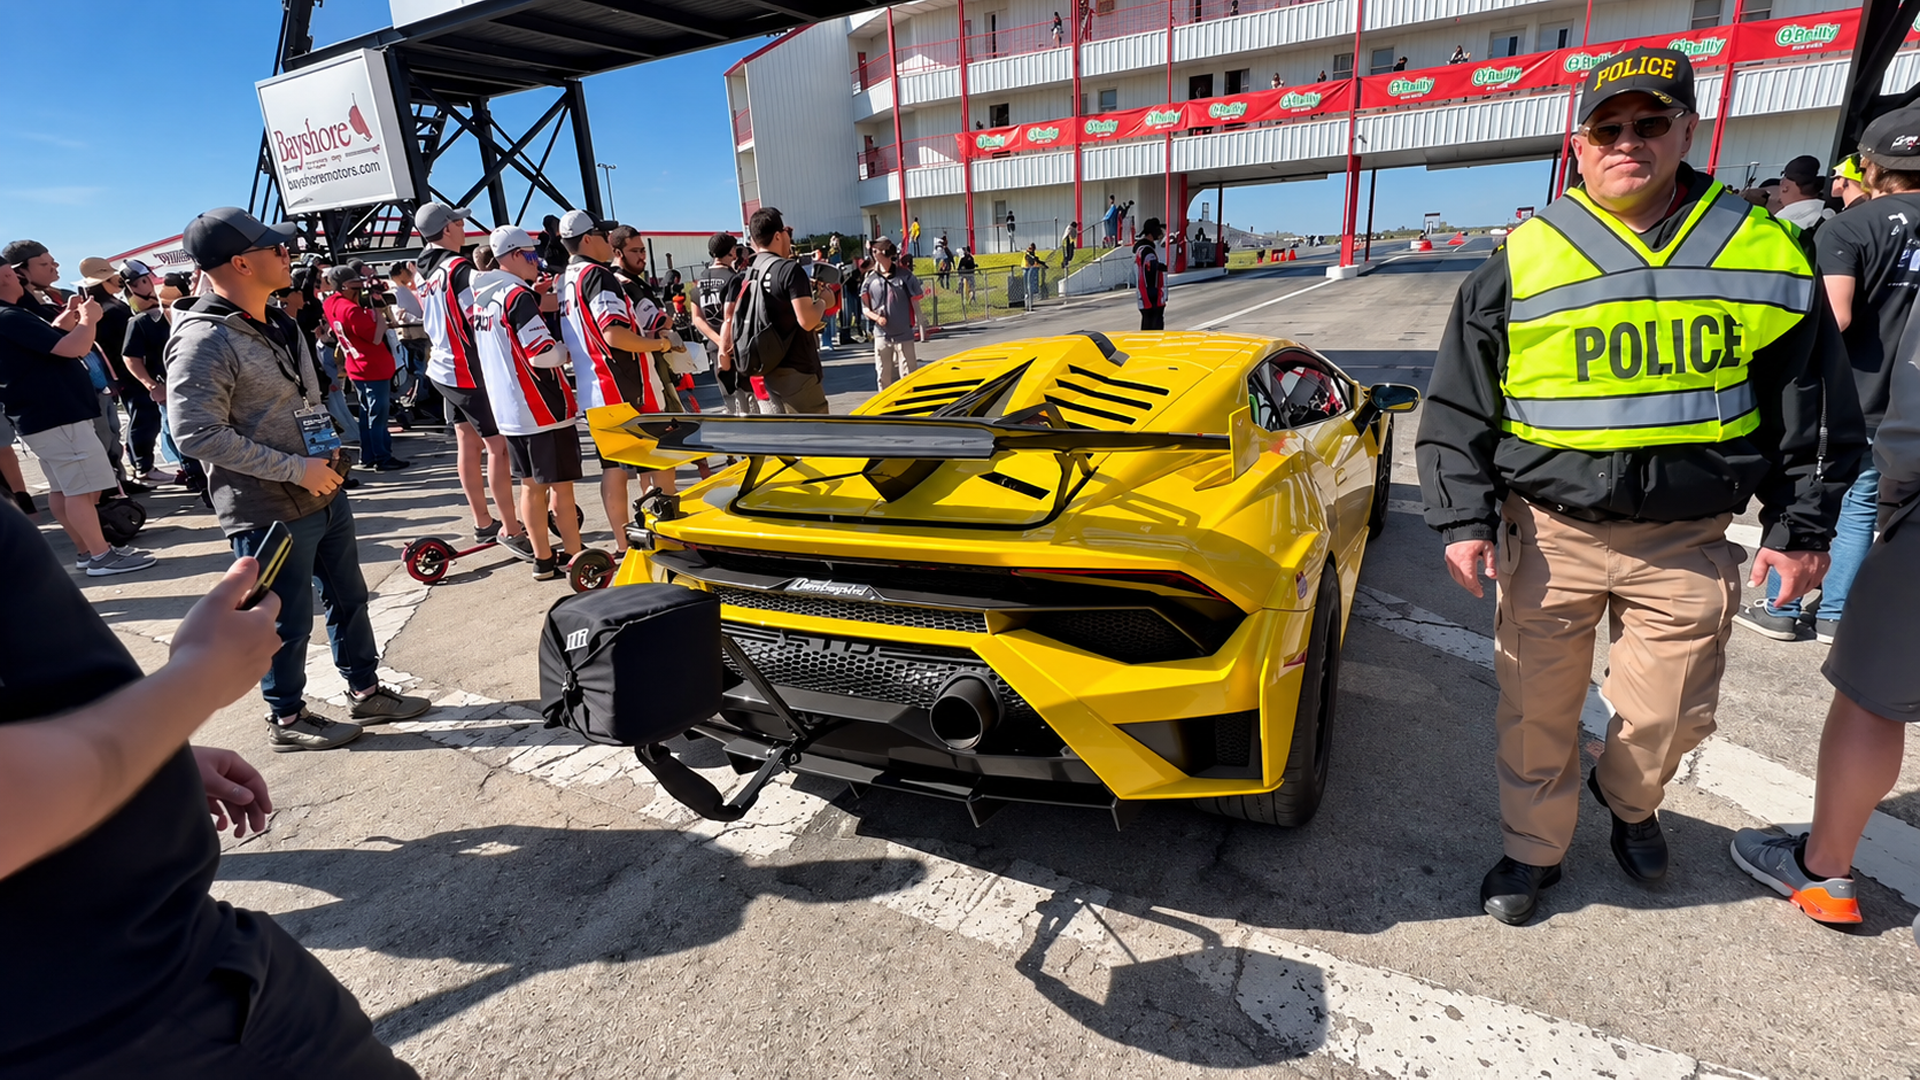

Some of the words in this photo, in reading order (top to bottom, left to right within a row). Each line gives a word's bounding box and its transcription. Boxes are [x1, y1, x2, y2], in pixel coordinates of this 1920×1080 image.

[1593, 57, 1677, 92] POLICE
[274, 118, 352, 170] Bayshore
[1574, 312, 1744, 382] POLICE
